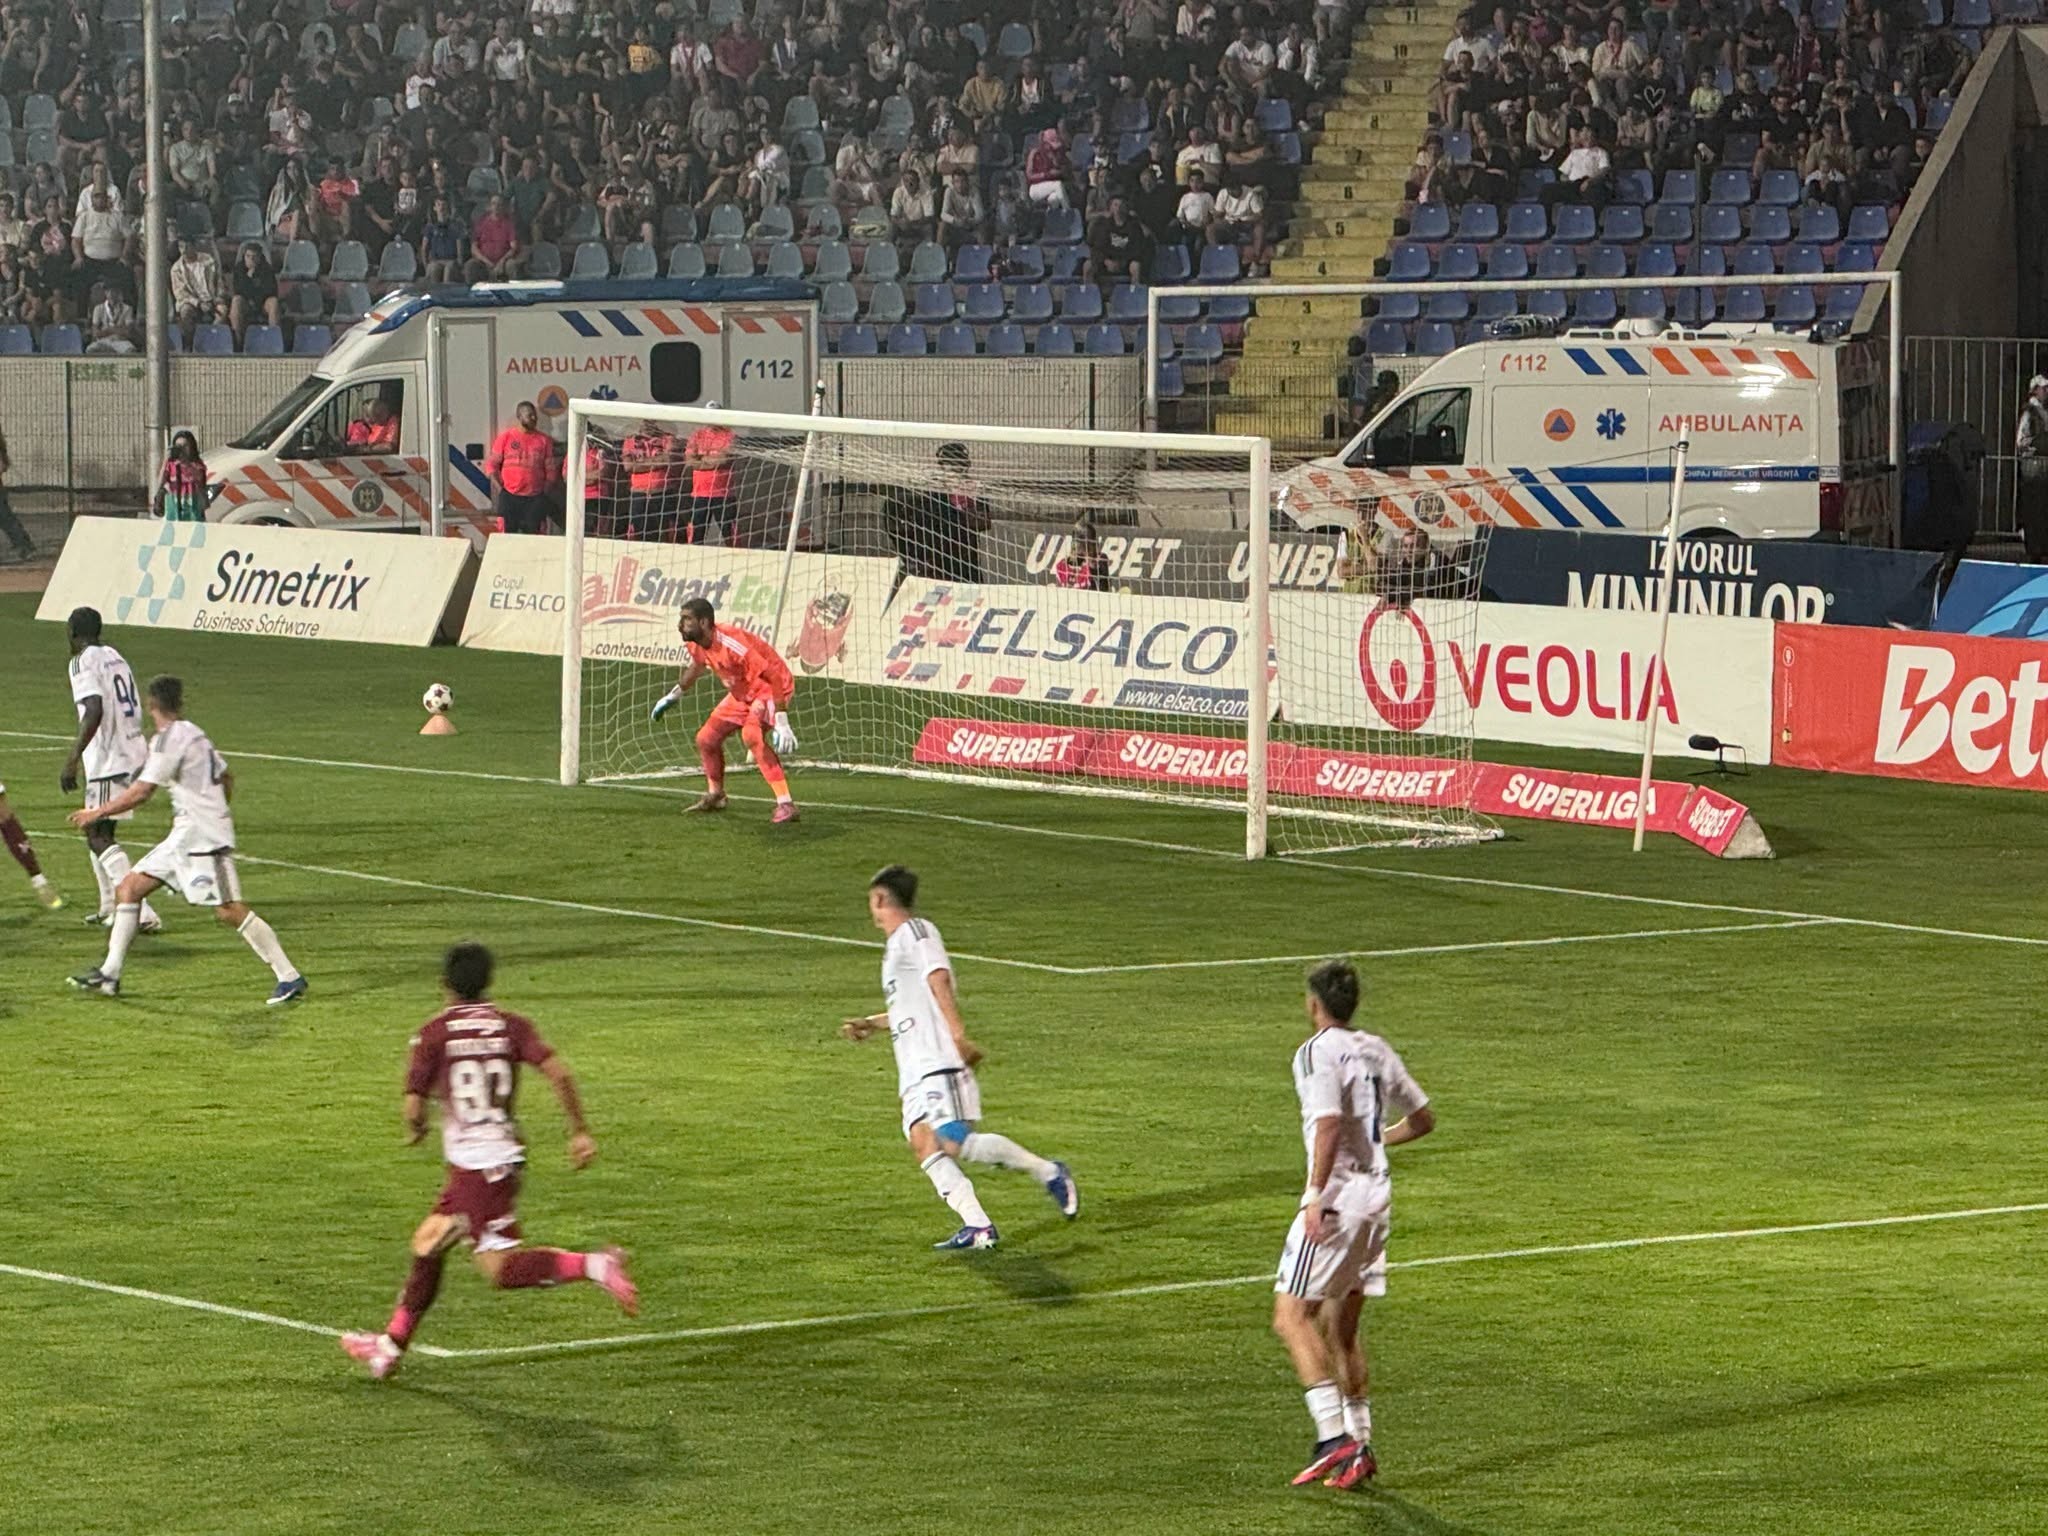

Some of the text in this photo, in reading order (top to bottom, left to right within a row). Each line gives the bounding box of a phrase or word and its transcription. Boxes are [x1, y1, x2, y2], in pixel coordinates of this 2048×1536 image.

[1335, 222, 1344, 236] 5
[1318, 261, 1327, 275] 4
[1302, 300, 1311, 314] 3
[755, 359, 794, 379] 112
[1514, 354, 1547, 372] 112
[1684, 469, 1711, 478] CHIPAJ
[1712, 469, 1746, 478] MEDICAL
[1749, 469, 1760, 478] DE
[1649, 540, 1758, 576] IZVORUL
[207, 549, 370, 611] Simetrix
[492, 574, 524, 592] Grupul
[634, 567, 732, 611] Smart
[489, 592, 566, 613] ELSACO
[193, 609, 320, 636] Business Software
[964, 608, 1239, 675] ELSACO
[1447, 641, 1680, 725] VEOLIA
[1124, 687, 1249, 717] www.elsaco.com
[1873, 643, 2048, 779] Bet
[946, 727, 1075, 764] SUPERBET
[1119, 734, 1249, 778] SUPERLIG
[1315, 759, 1456, 798] SUPERBET
[1501, 773, 1656, 822] SUPERLIGA
[1687, 795, 1738, 838] SUPERBET
